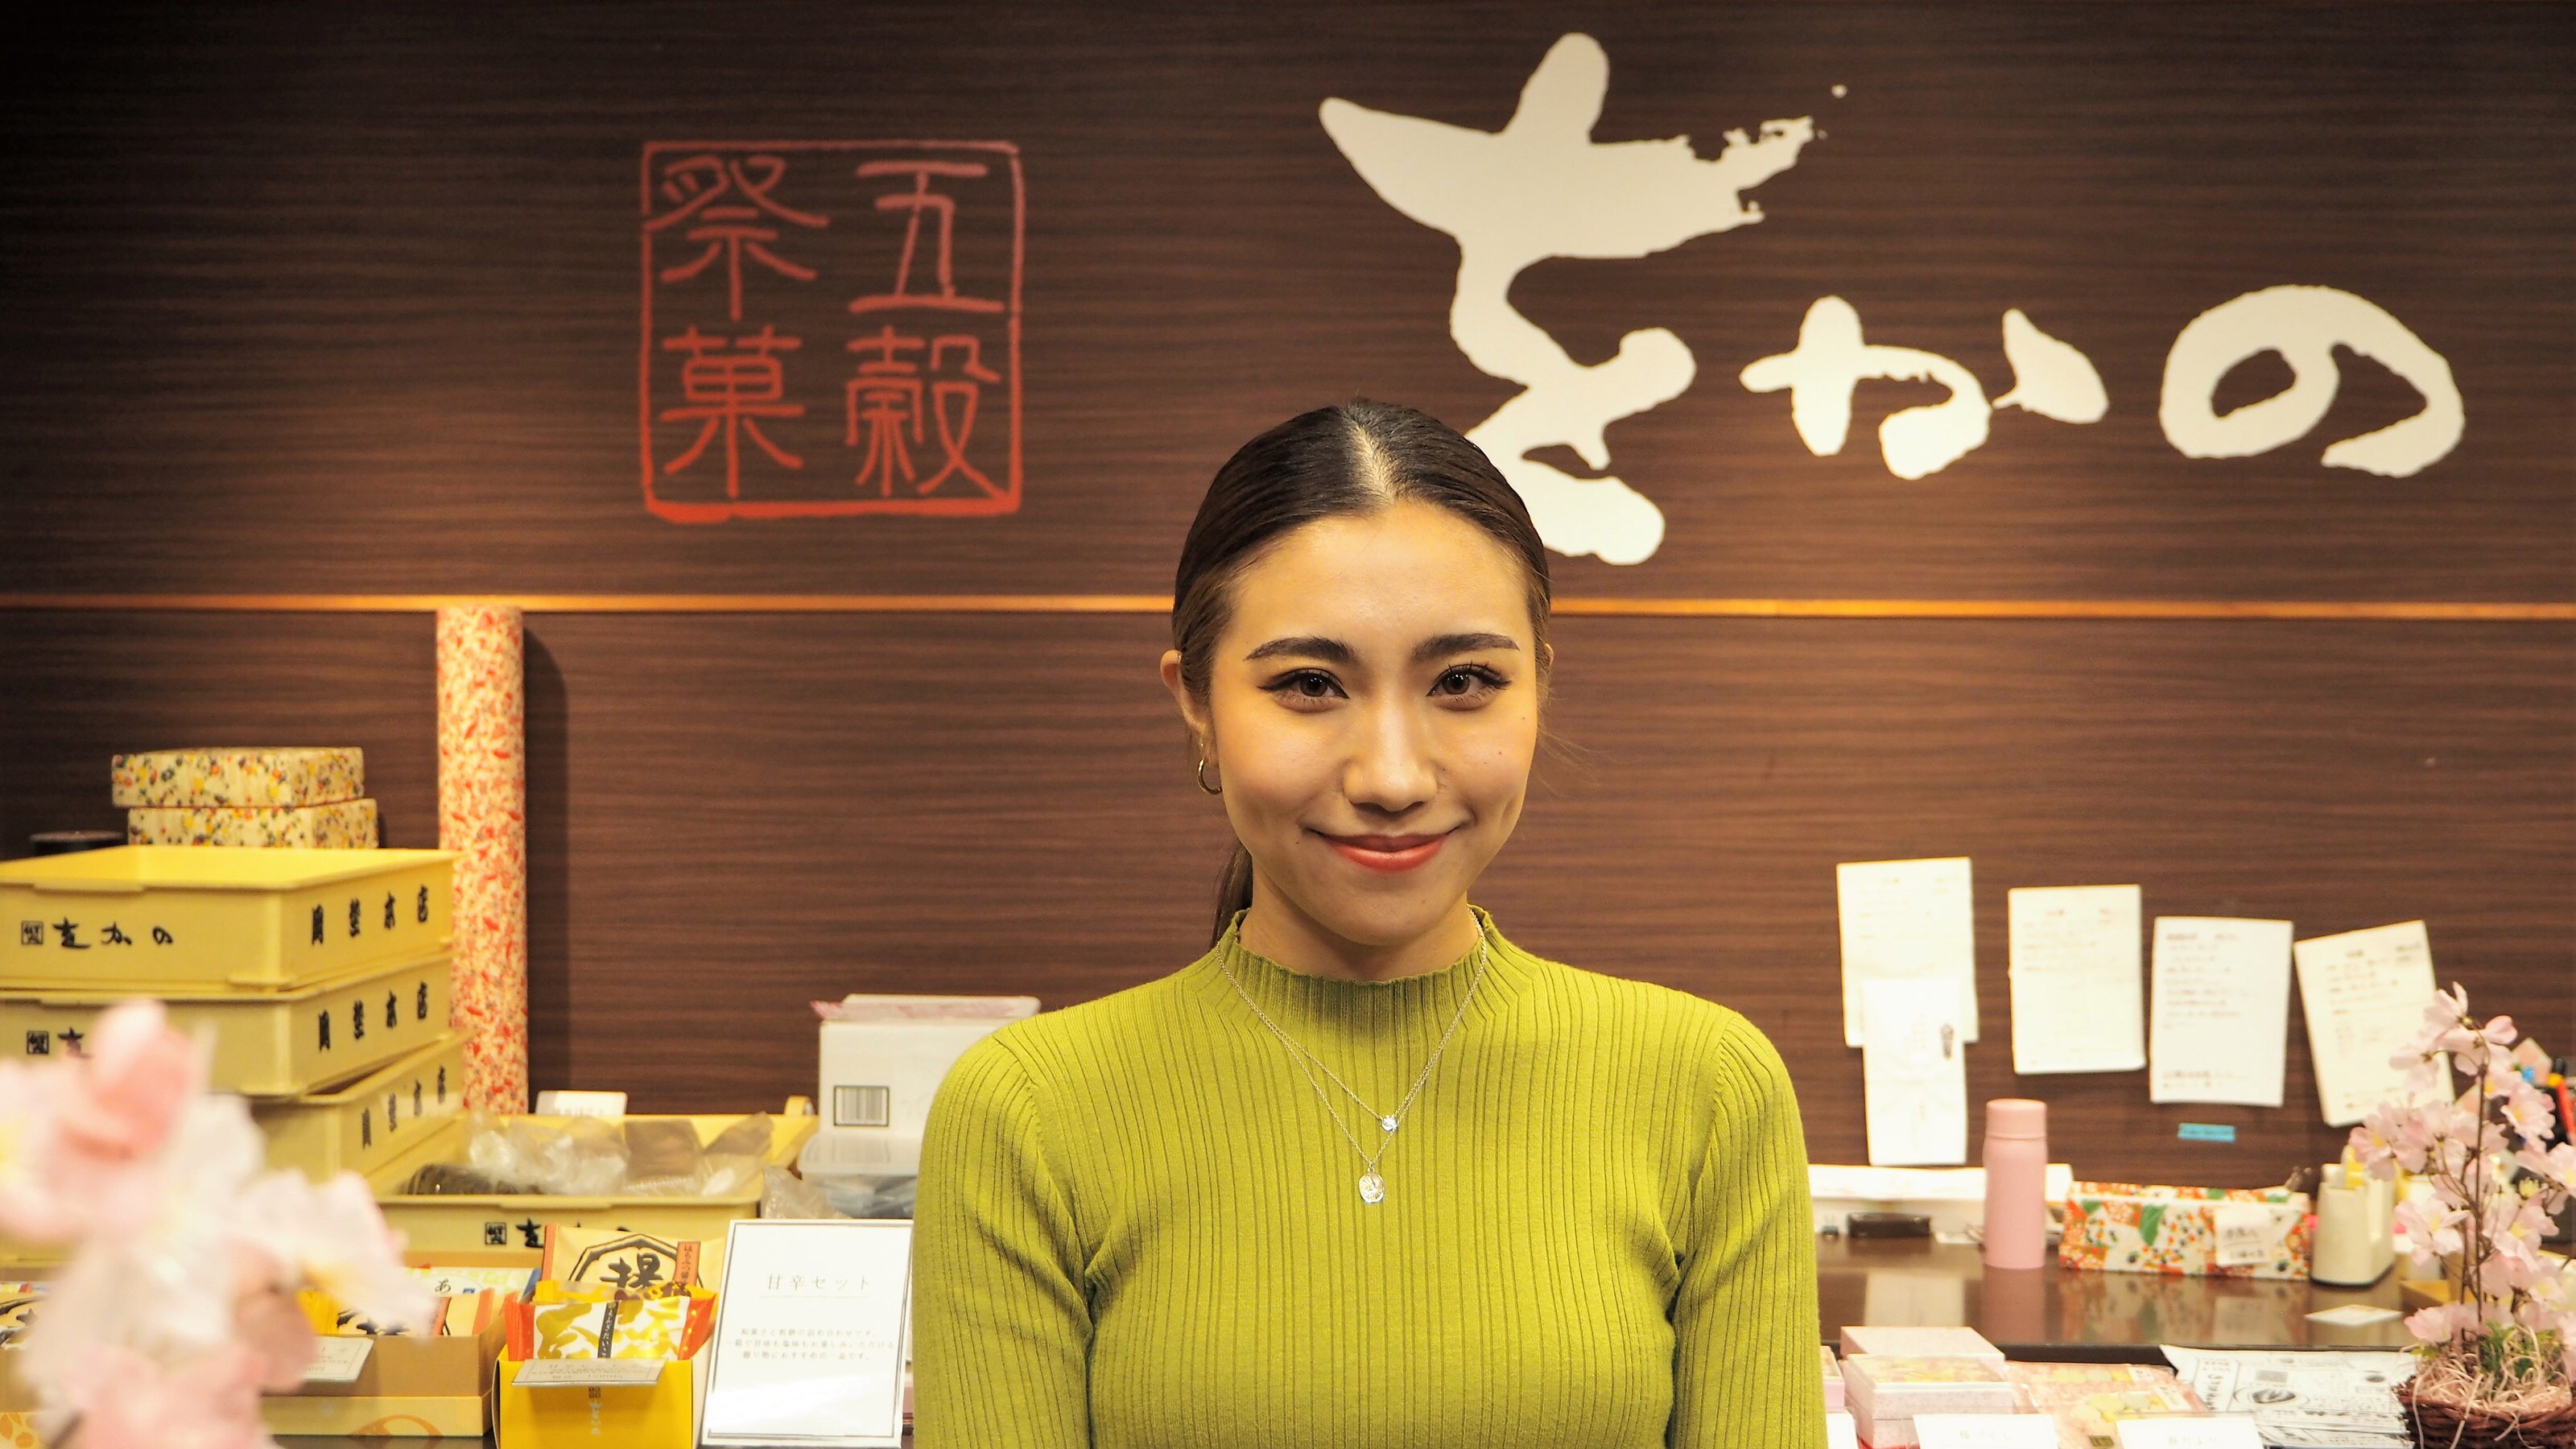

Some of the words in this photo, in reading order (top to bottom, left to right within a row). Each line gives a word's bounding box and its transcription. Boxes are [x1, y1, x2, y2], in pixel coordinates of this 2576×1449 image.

[845, 161, 1011, 497] 五穀
[1319, 32, 2466, 565] をかの
[767, 1274, 870, 1290] 甘辛セット
